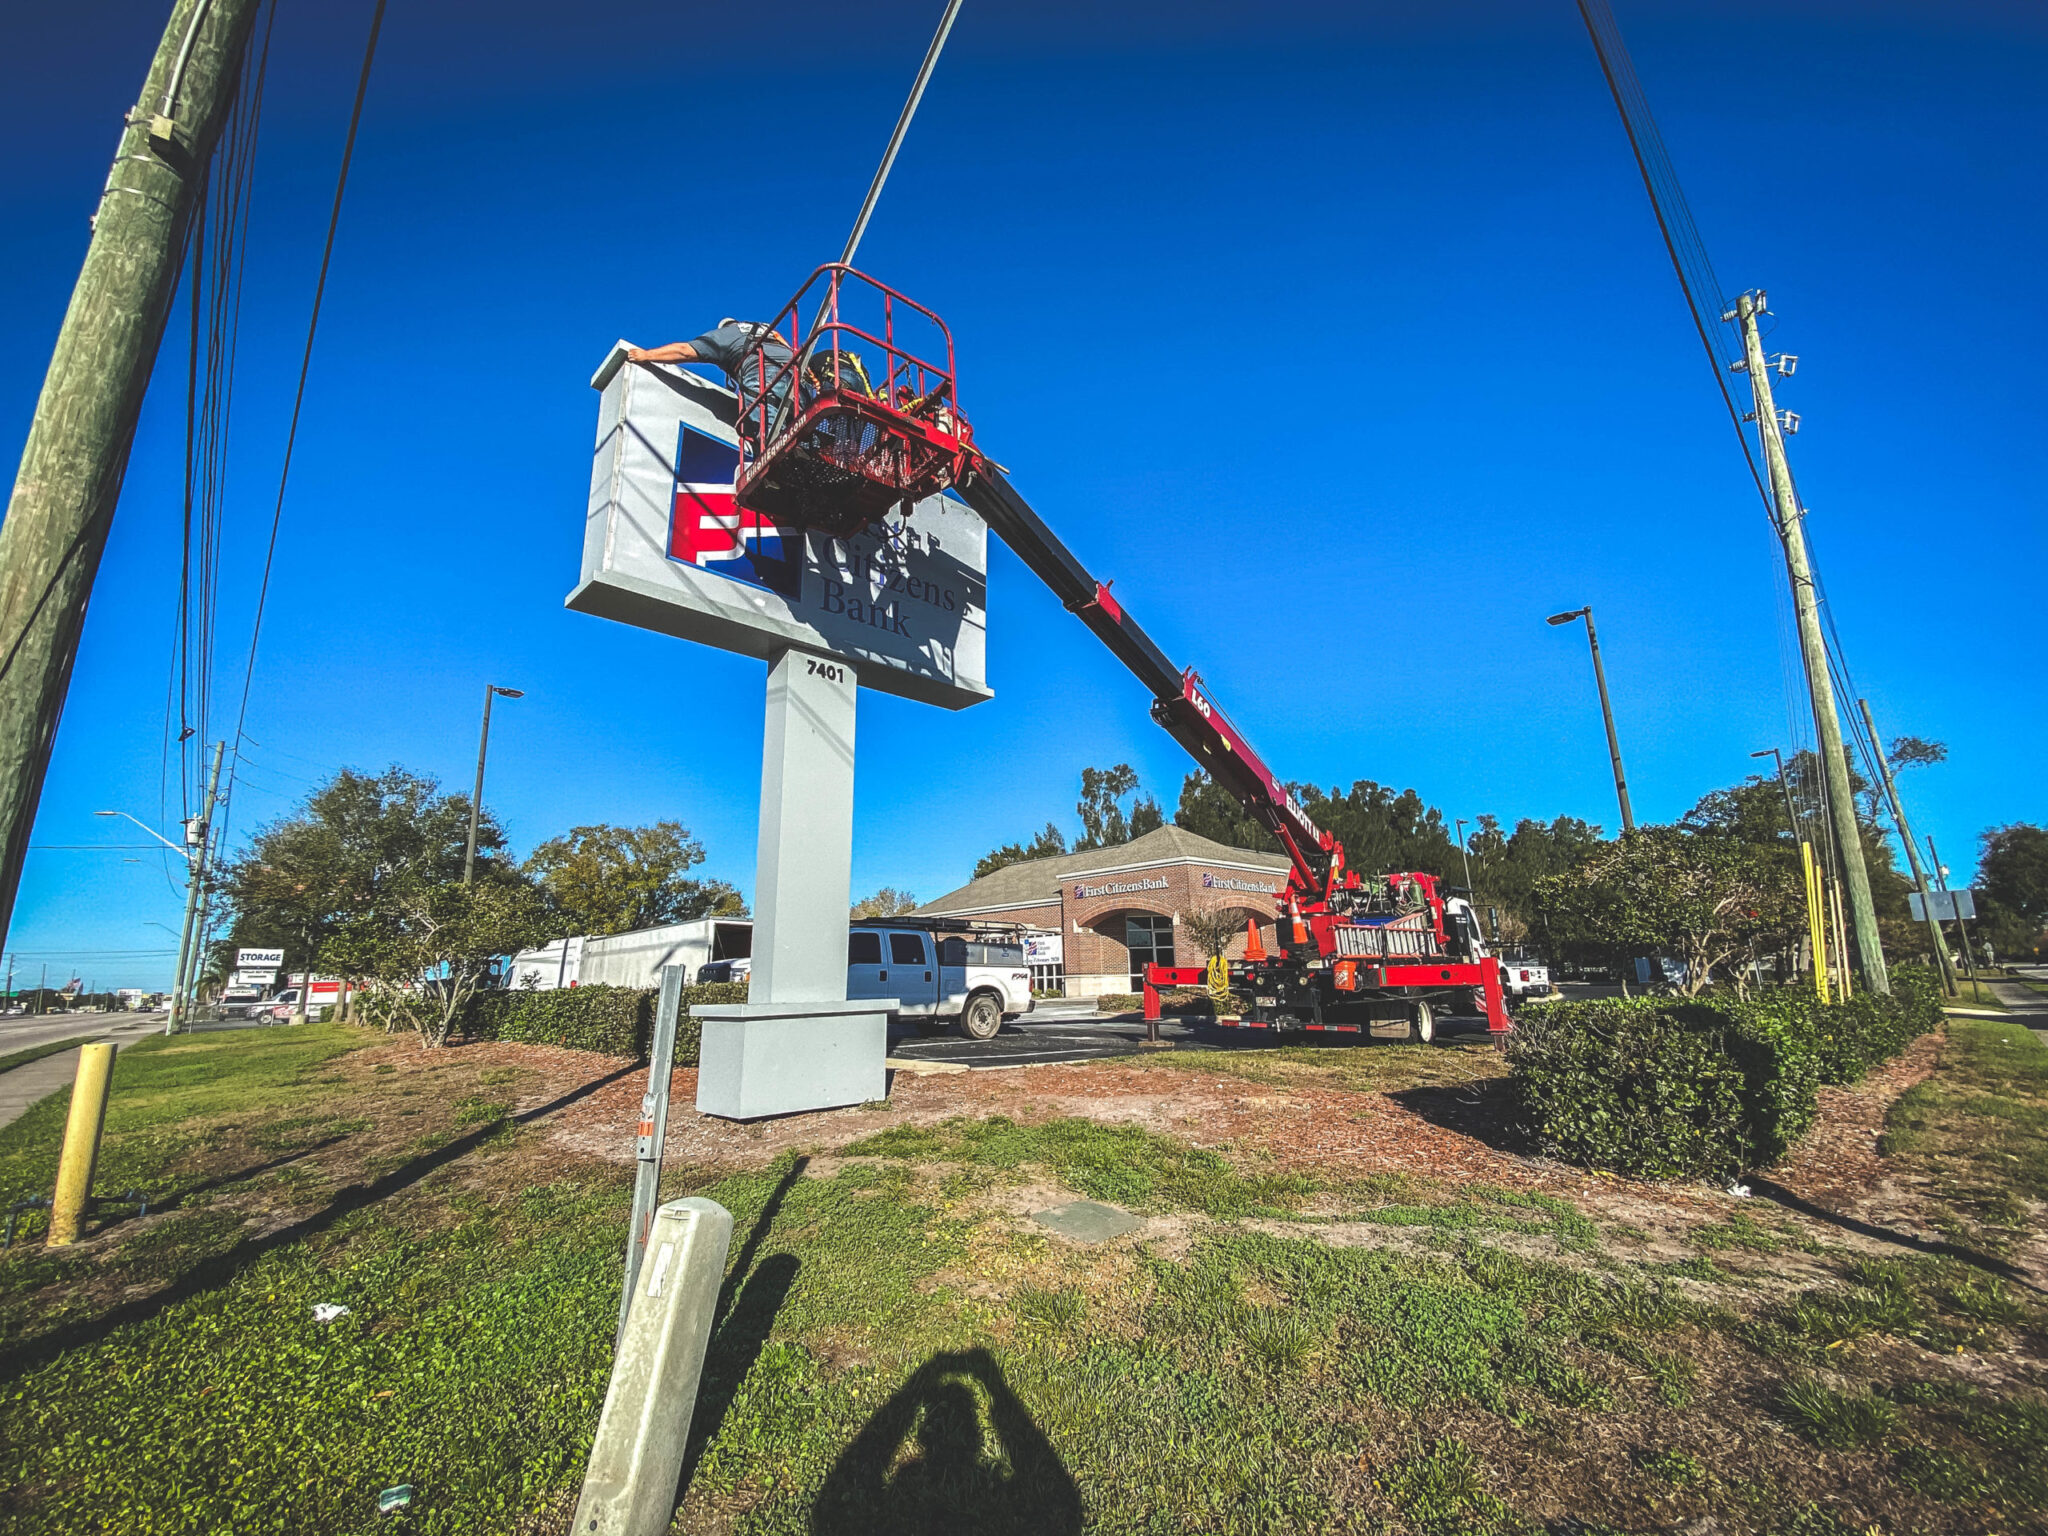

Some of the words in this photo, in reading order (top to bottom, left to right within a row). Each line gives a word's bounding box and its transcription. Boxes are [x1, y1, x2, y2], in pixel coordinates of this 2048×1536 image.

[823, 535, 956, 612] Citizens
[820, 577, 912, 639] Bank
[807, 660, 844, 684] 7401
[1191, 688, 1211, 718] L60
[240, 953, 281, 961] STORAGE
